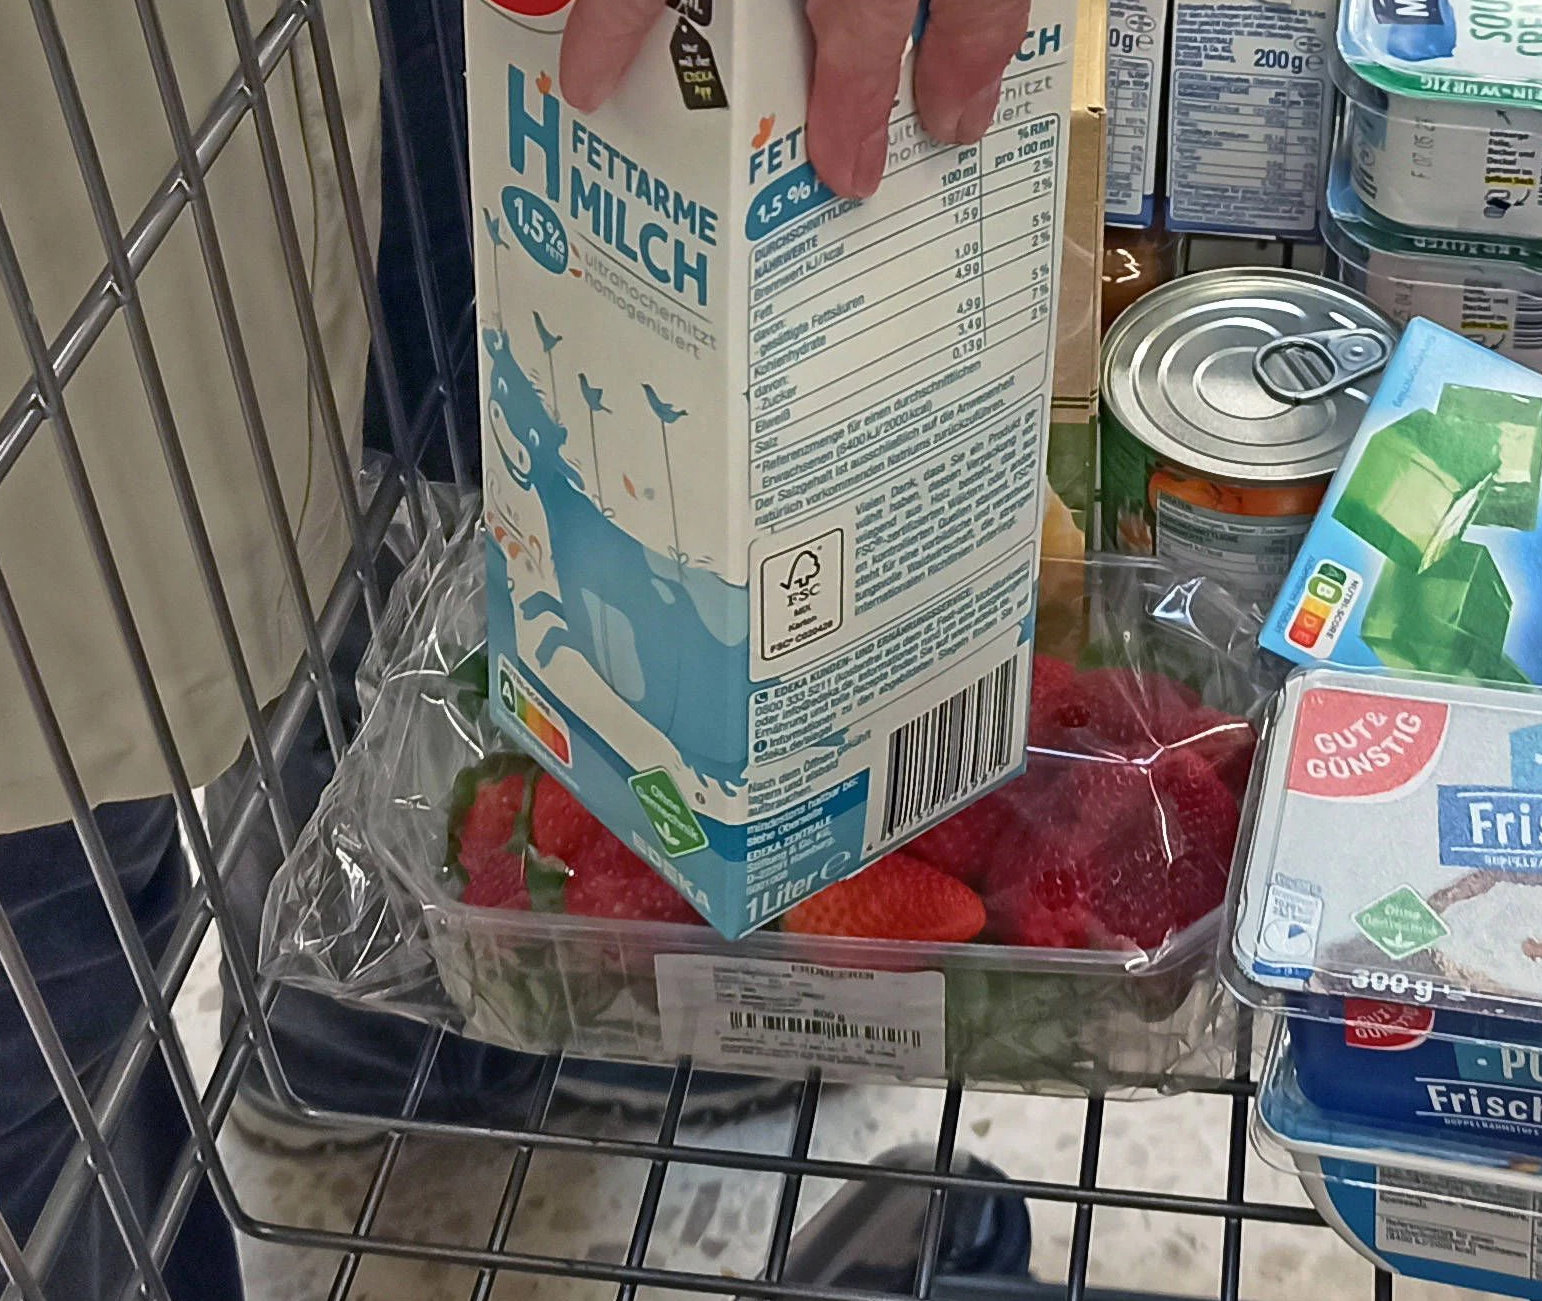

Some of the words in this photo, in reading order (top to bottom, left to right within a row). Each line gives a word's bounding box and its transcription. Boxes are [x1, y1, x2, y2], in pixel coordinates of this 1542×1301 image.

[508, 63, 560, 203] H
[958, 147, 978, 166] pro
[994, 150, 1015, 168] pro
[572, 119, 718, 247] FETTARME
[758, 194, 783, 224] 1,5
[571, 165, 708, 306] MILCH
[585, 252, 718, 350] ultrahocherhitzt
[585, 267, 702, 361] homogenisiert
[787, 582, 821, 607] FSC
[1306, 712, 1424, 781] GÜNSTIG
